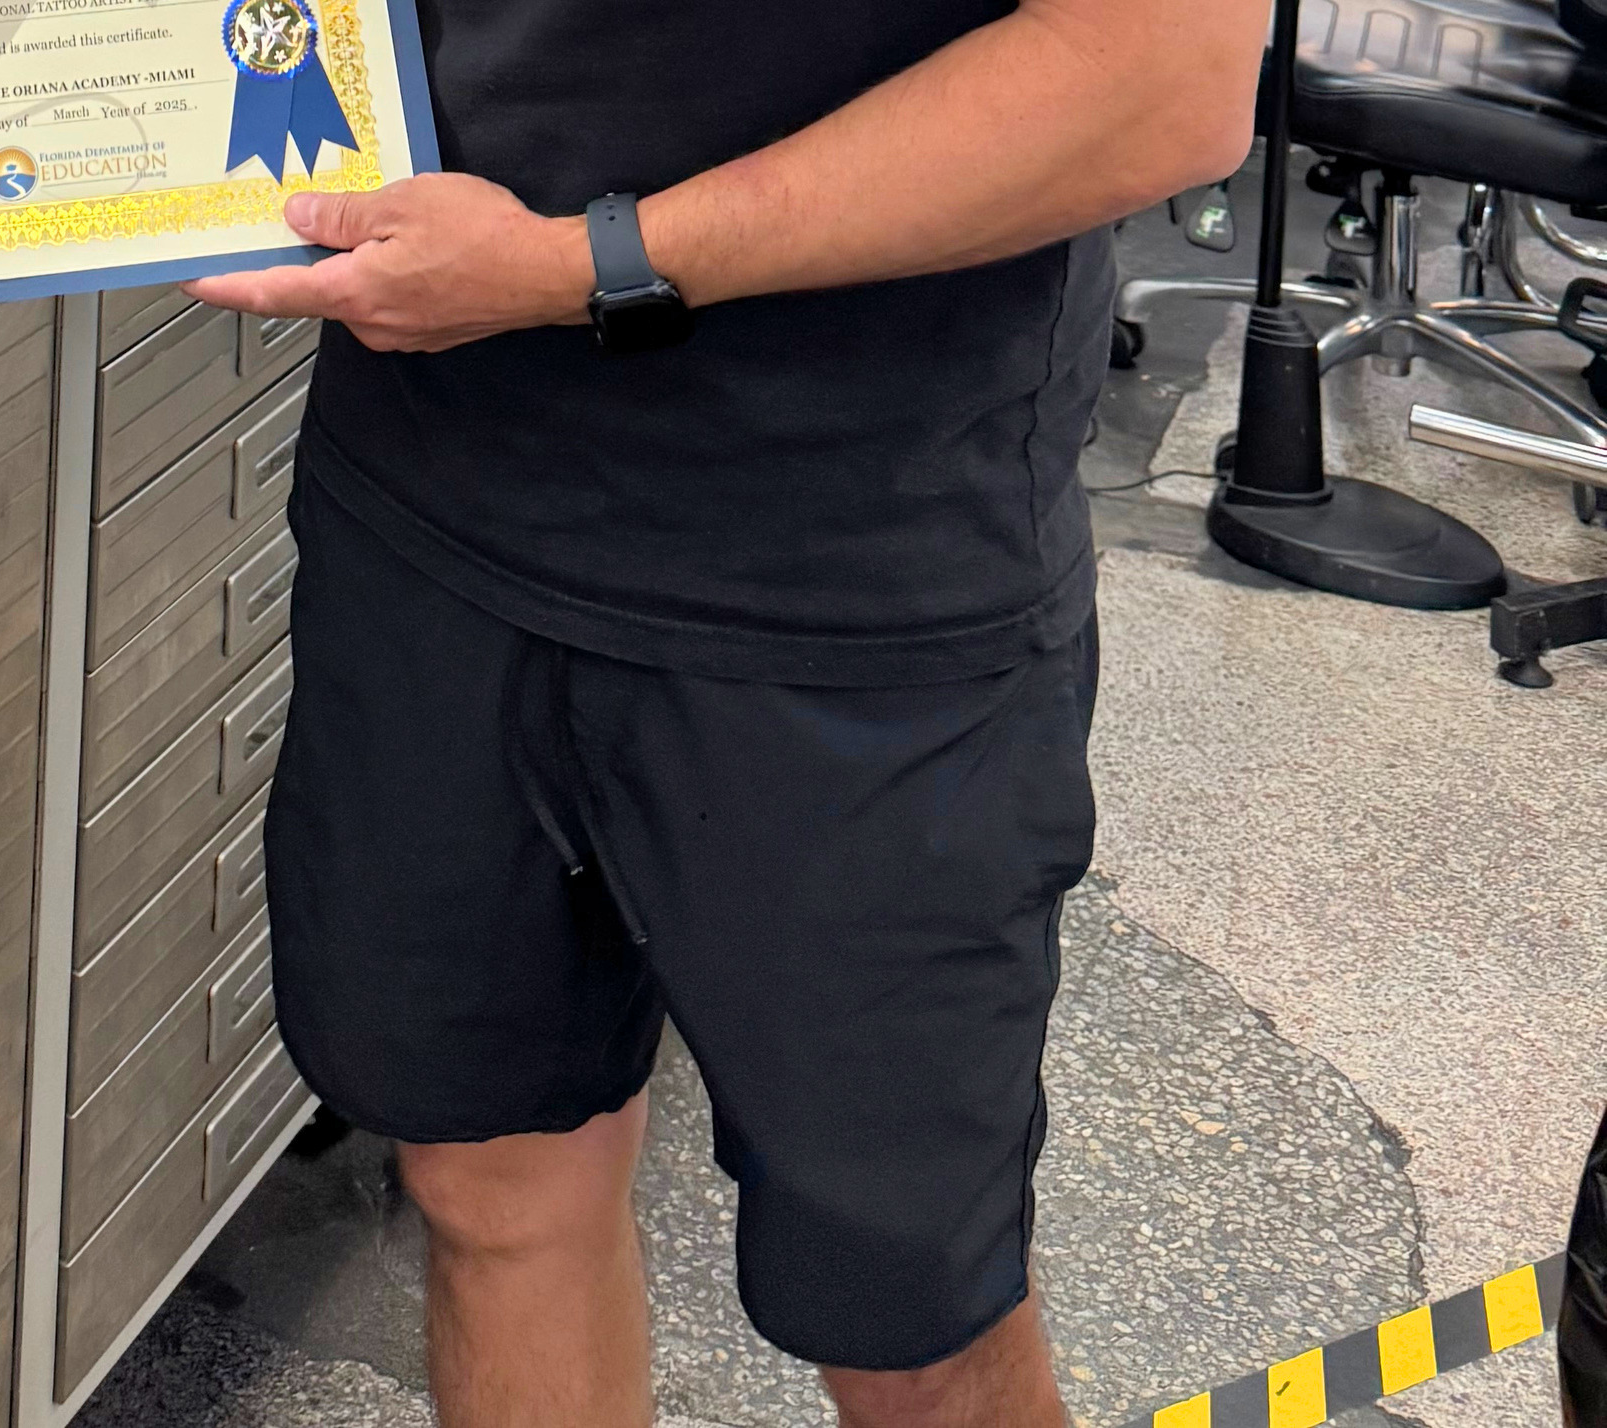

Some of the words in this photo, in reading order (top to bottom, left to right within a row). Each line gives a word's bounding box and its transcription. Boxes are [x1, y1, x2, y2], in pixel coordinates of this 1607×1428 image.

[10, 40, 20, 54] is
[23, 34, 77, 53] awarded
[80, 32, 104, 47] this
[106, 27, 173, 44] certificate.
[12, 81, 68, 98] ORIANA
[71, 73, 142, 91] ACADEMY
[143, 68, 196, 83] -MIAMI
[15, 114, 30, 127] of
[53, 105, 90, 121] March
[100, 107, 130, 120] Year
[133, 102, 147, 115] of
[154, 99, 188, 112] 2025
[41, 152, 167, 182] EDUCATION
